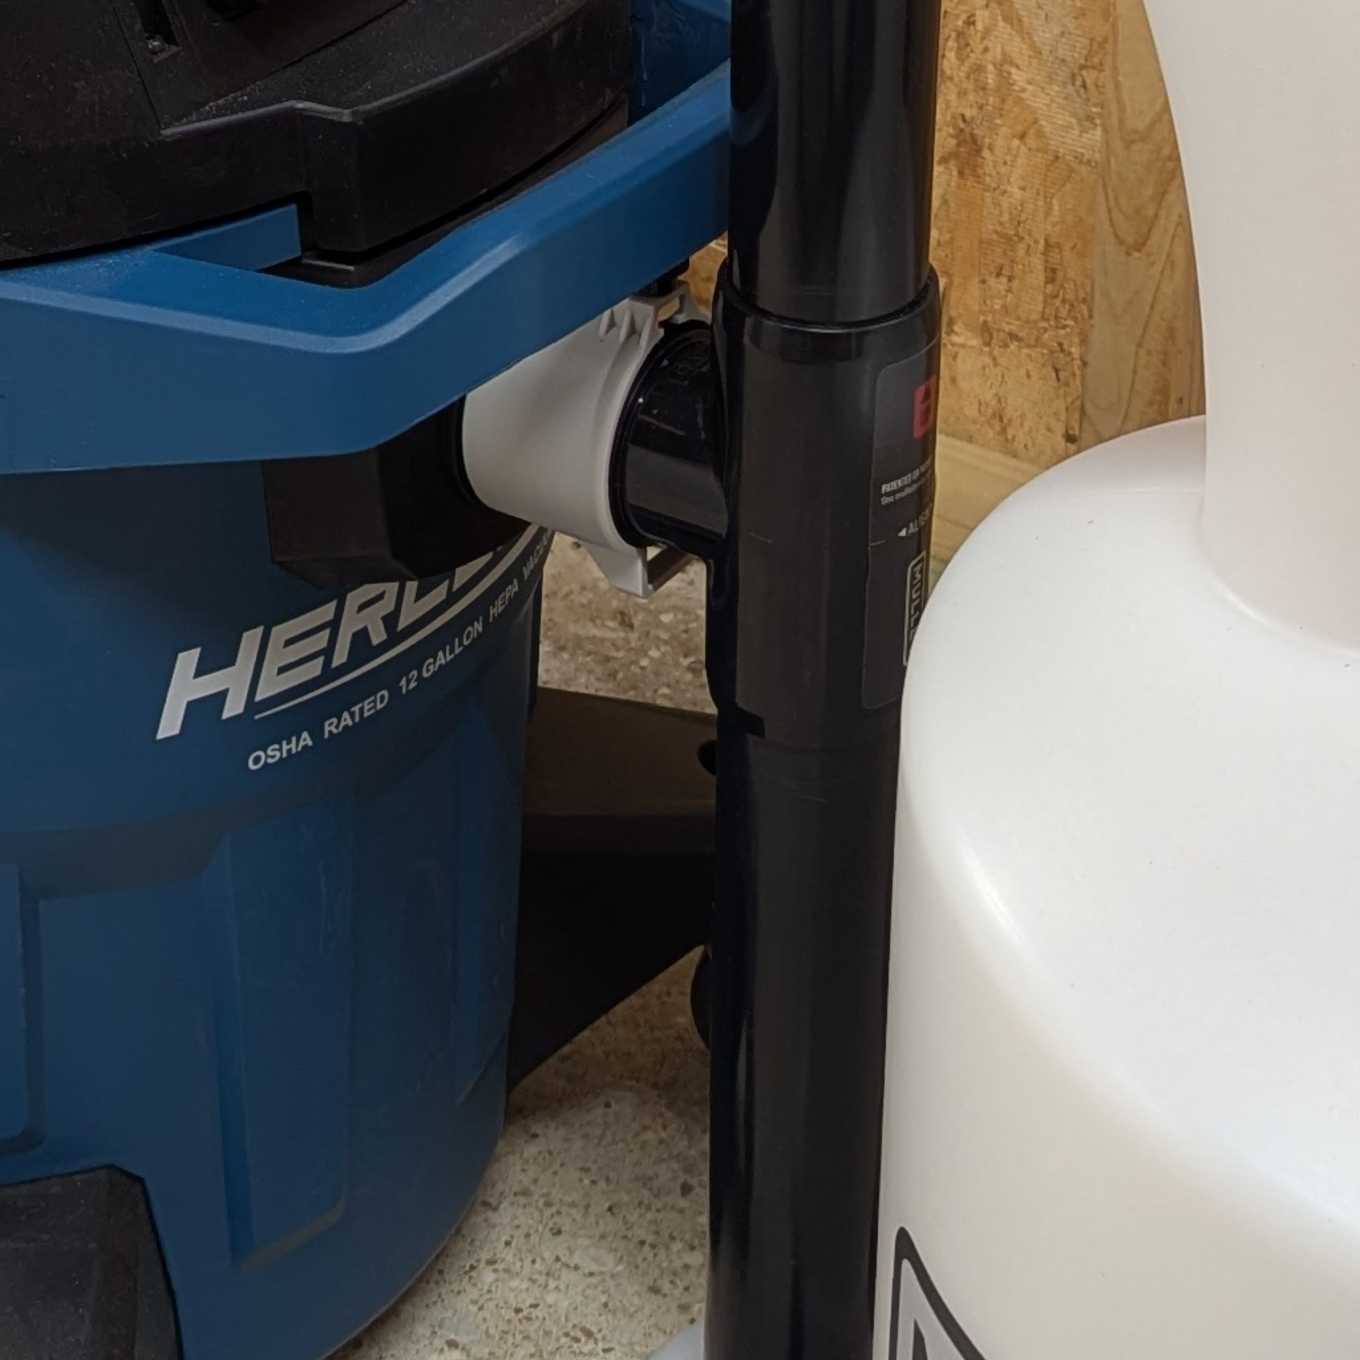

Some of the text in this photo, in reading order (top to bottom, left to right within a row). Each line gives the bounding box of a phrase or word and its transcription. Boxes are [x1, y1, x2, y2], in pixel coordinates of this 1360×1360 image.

[248, 731, 313, 770] OSHA
[324, 689, 389, 739] RATED
[399, 673, 418, 694] 12
[422, 616, 483, 678] GALLON
[489, 578, 518, 622] HEPA
